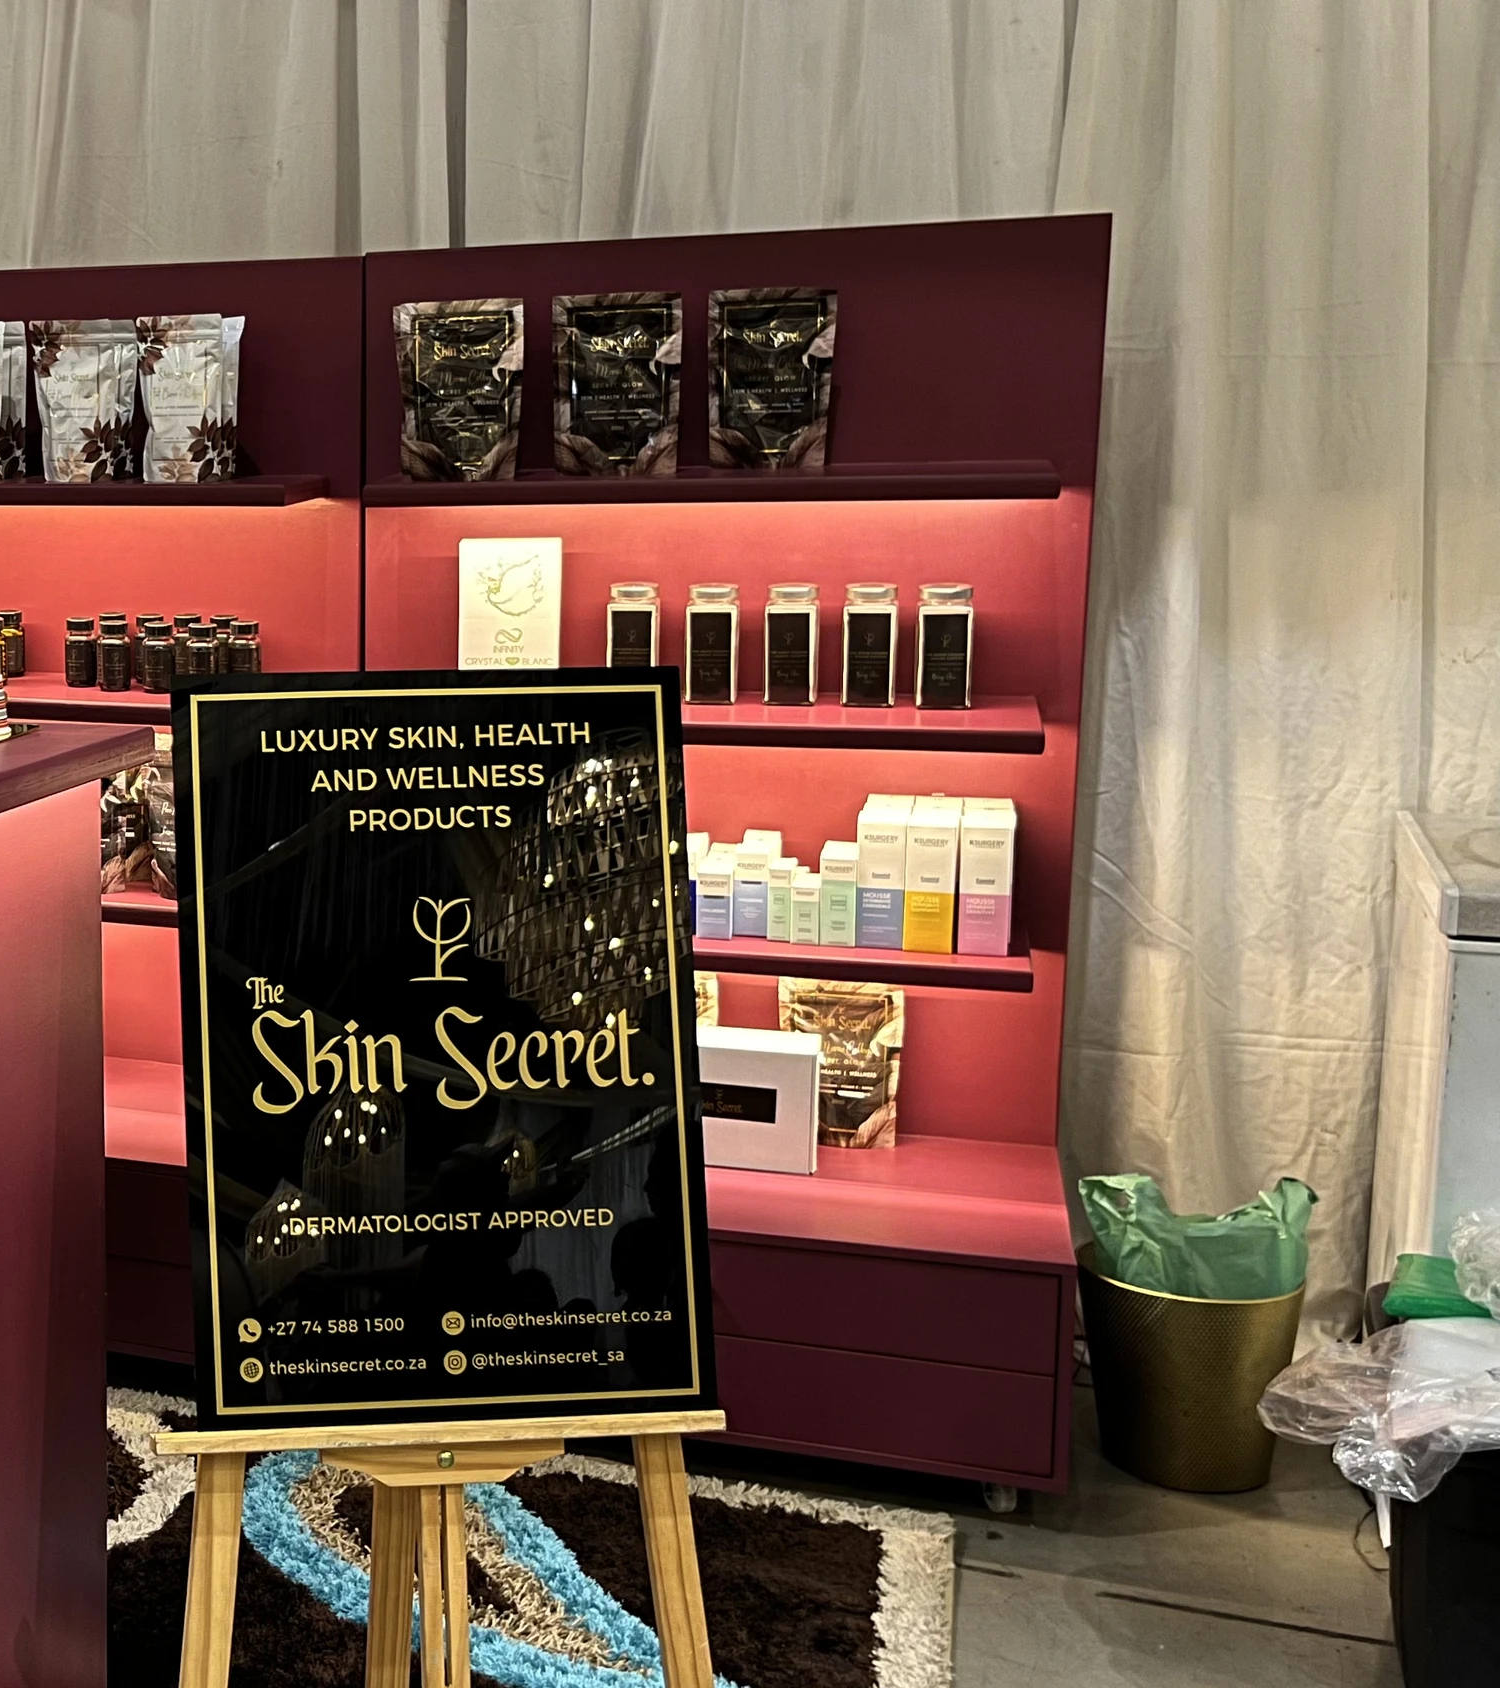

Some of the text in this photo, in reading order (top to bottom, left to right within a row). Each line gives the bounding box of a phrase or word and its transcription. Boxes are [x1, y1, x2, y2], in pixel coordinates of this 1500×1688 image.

[492, 645, 525, 653] INFINITY
[464, 657, 554, 666] CRYSTAL BLANC
[260, 722, 591, 753] LUXURY SKIN, HEALTH
[311, 763, 545, 793] AND WELLNESS
[349, 805, 512, 832] PRODUCTS
[864, 834, 898, 842] KSURGERY
[914, 837, 949, 845] KSURGERY
[969, 839, 1005, 847] KSURGERY
[862, 891, 892, 900] MOUSSE
[246, 977, 284, 1010] The
[252, 1006, 656, 1115] Skin Secret.
[288, 1207, 615, 1237] DERMATOLOGIST APPROVED
[267, 1317, 405, 1336] +27 74 588 1500
[470, 1310, 672, 1330] info@theskinsecret.co.za
[269, 1358, 428, 1376] theskinsecret.co.za
[472, 1350, 625, 1370] @theskinsecret_sa
